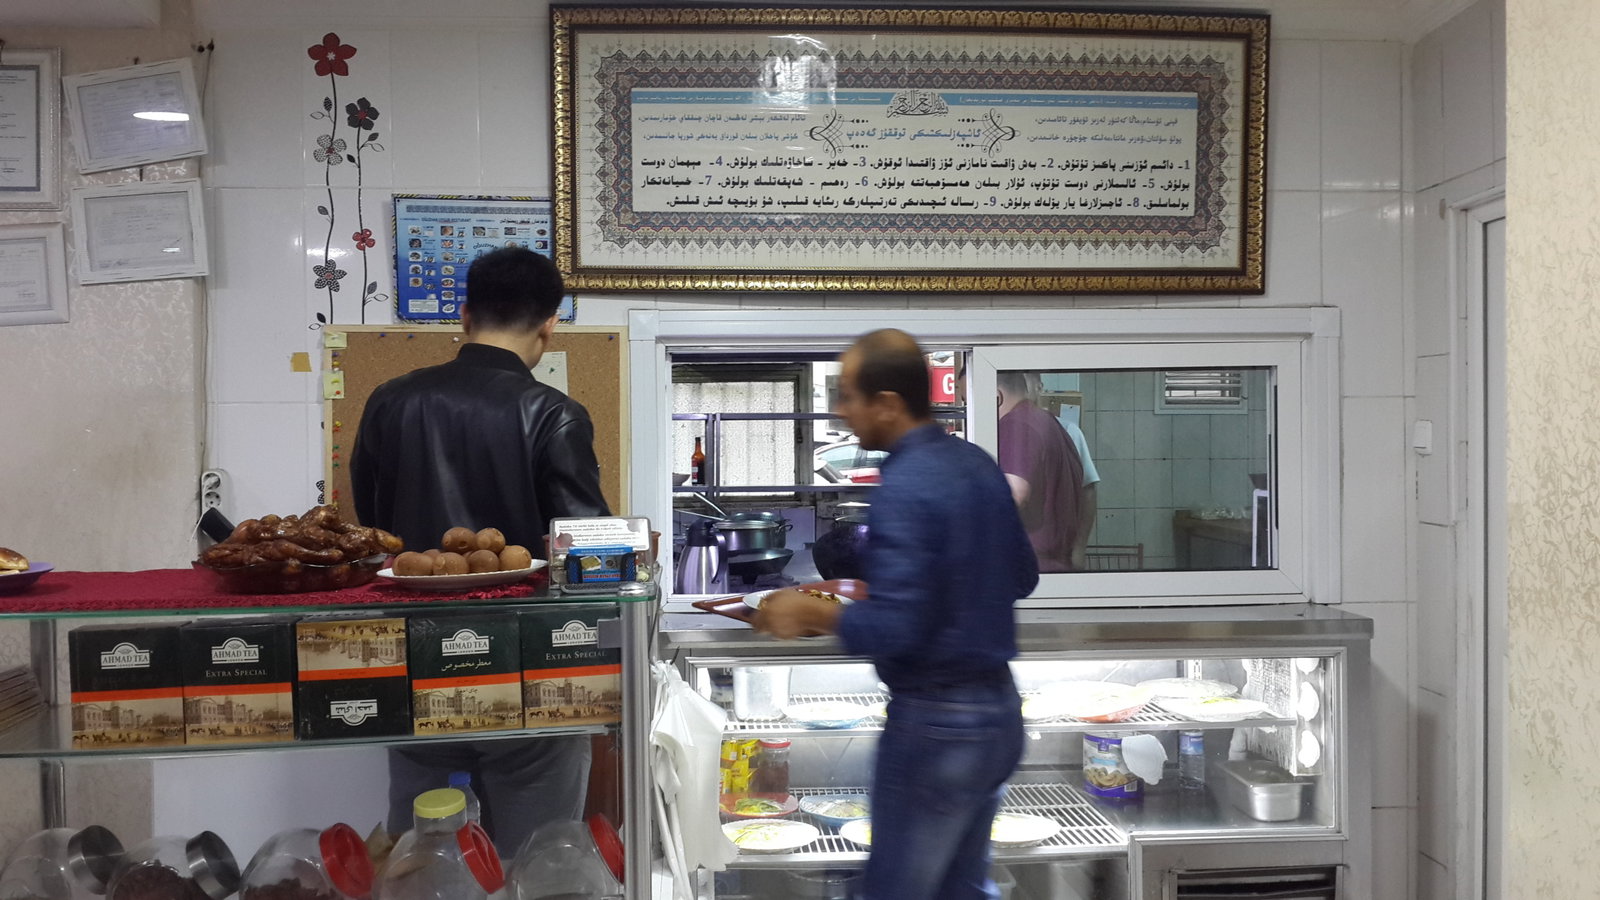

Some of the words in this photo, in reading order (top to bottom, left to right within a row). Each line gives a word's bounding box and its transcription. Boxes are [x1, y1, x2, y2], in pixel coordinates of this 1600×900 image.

[641, 158, 665, 169] دوست
[956, 158, 987, 170] نامازنى
[1018, 159, 1037, 171] بەش
[975, 177, 1000, 189] بىلەن
[1065, 180, 1088, 191] دوست
[1063, 197, 1075, 210] يار
[553, 633, 582, 642] AHMAD
[582, 632, 597, 640] TEA
[443, 642, 472, 651] AHMAD
[473, 641, 488, 649] TEA
[103, 655, 132, 664] AHMAD
[213, 650, 242, 659] AHMAD
[243, 649, 258, 657] TEA
